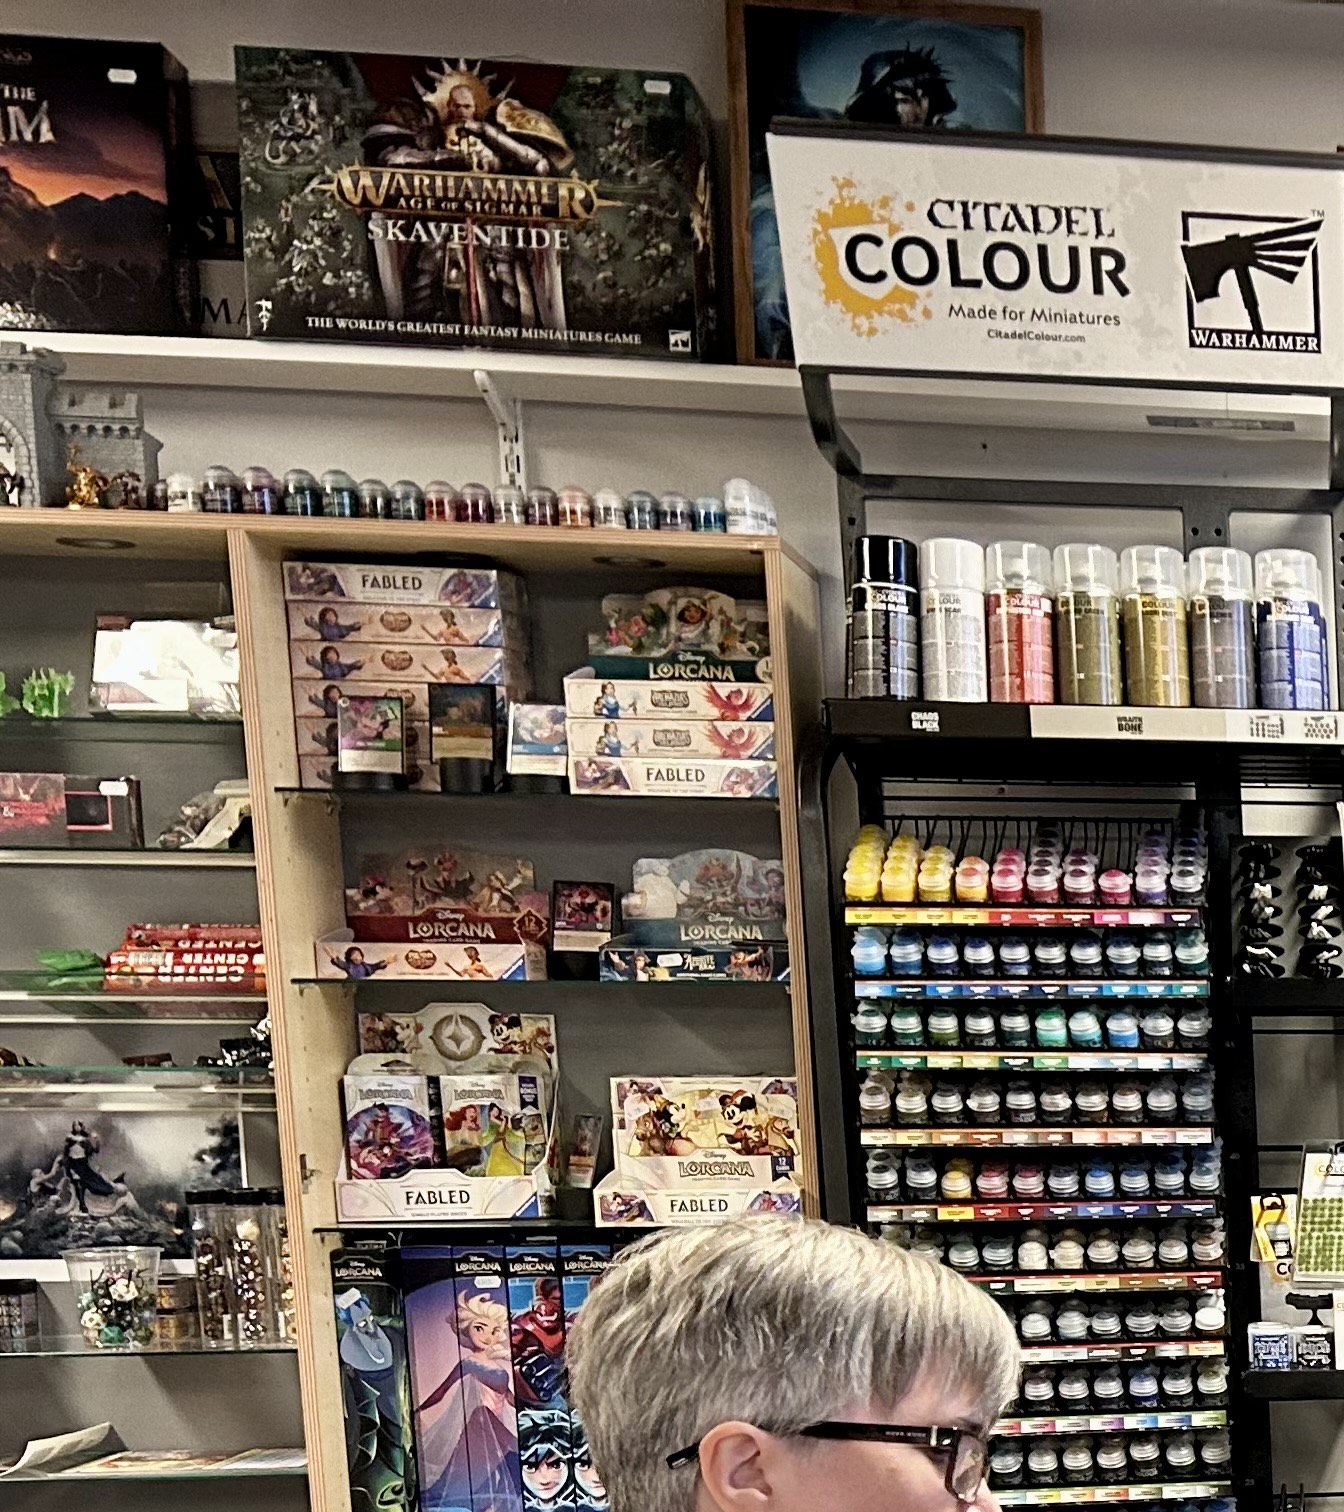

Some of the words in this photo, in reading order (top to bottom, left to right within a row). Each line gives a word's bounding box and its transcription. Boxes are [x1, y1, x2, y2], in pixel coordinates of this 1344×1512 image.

[340, 169, 592, 218] WARHAMMER
[397, 198, 433, 214] AGE
[926, 198, 1116, 239] CITADEL
[367, 219, 571, 252] SKAVENTIDE
[844, 233, 1132, 299] COLOUR
[948, 304, 998, 323] Made
[1002, 305, 1027, 324] for
[1030, 307, 1122, 328] Miniatures
[306, 316, 333, 330] THE
[336, 317, 395, 334] WORLD'S
[397, 320, 462, 337] GREATEST
[463, 324, 520, 341] FANTASY
[604, 331, 643, 346] GAME
[986, 328, 1087, 344] CitadelColour.com
[1191, 329, 1320, 352] WARHAMMER
[361, 572, 422, 592] FABLED
[648, 663, 735, 682] LORCANA
[1117, 723, 1143, 733] BONE
[645, 766, 705, 783] FABLED
[408, 921, 496, 941] LORCANA
[680, 922, 764, 941] LORCANA
[181, 953, 249, 965] CENTER
[677, 1160, 755, 1178] LORCANA
[405, 1190, 471, 1206] FABLED
[670, 1199, 729, 1213] FABLED
[335, 1267, 383, 1279] LORCANA
[455, 1261, 501, 1273] LORCANA
[509, 1262, 555, 1273] LORCANA
[564, 1261, 608, 1271] LORCANA
